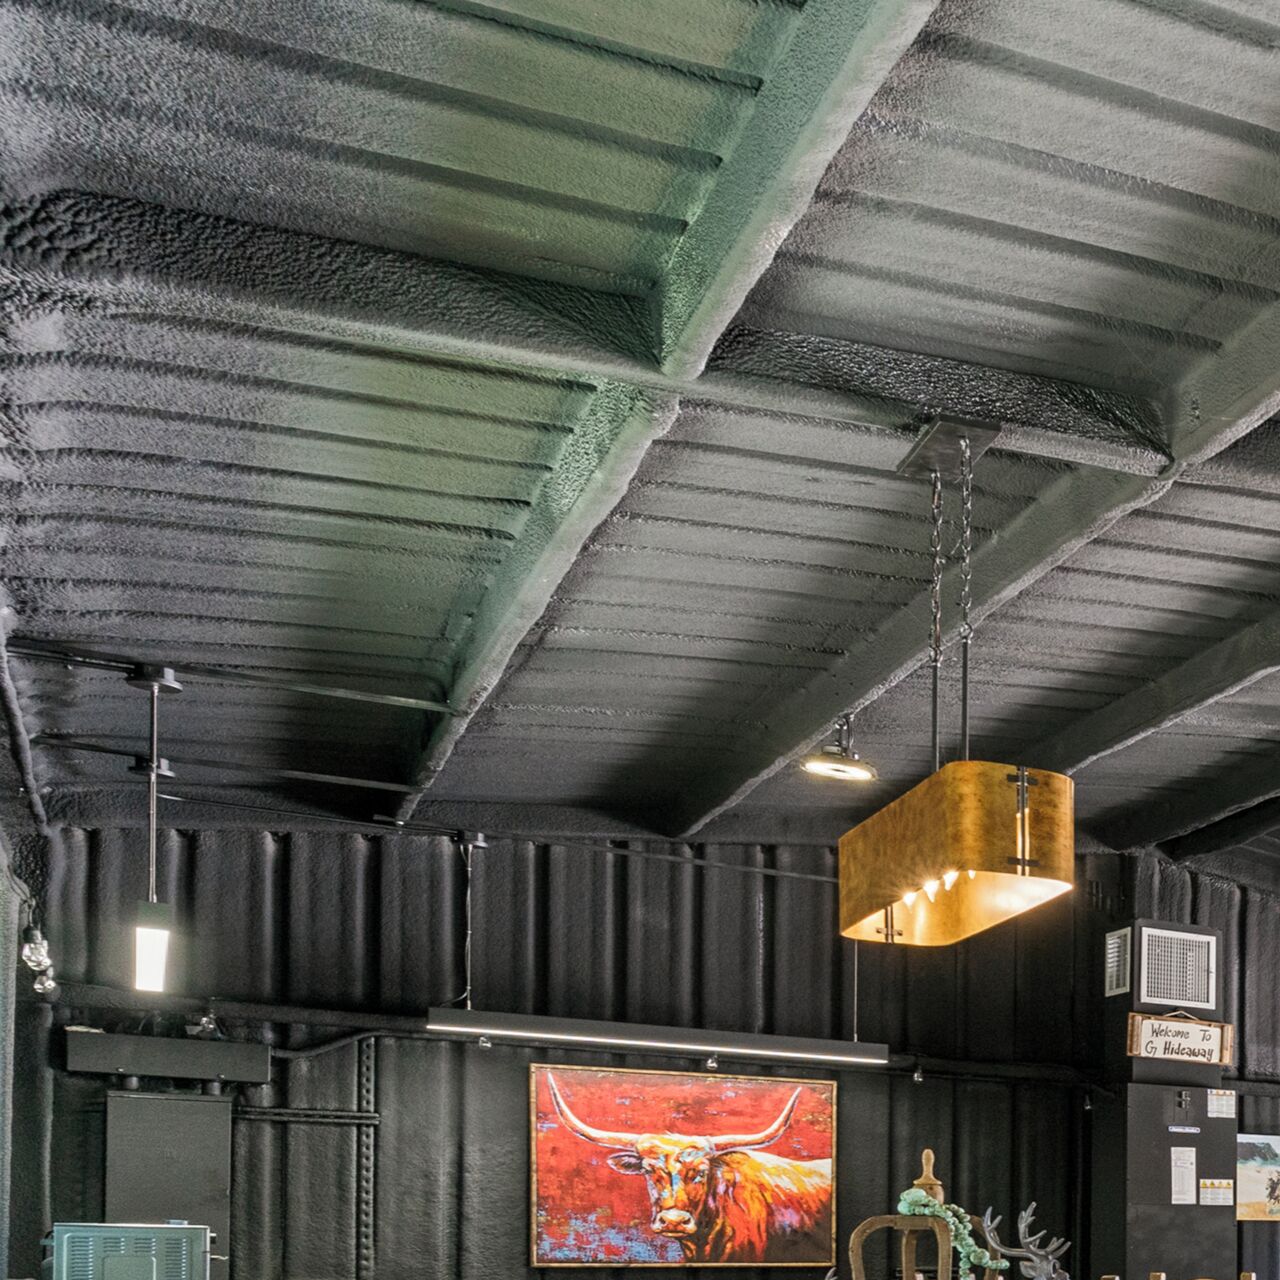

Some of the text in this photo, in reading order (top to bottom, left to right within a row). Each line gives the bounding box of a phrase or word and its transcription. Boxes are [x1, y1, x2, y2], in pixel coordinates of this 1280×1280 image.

[1151, 1023, 1212, 1041] Welcome To
[1163, 1041, 1214, 1062] Hideaway
